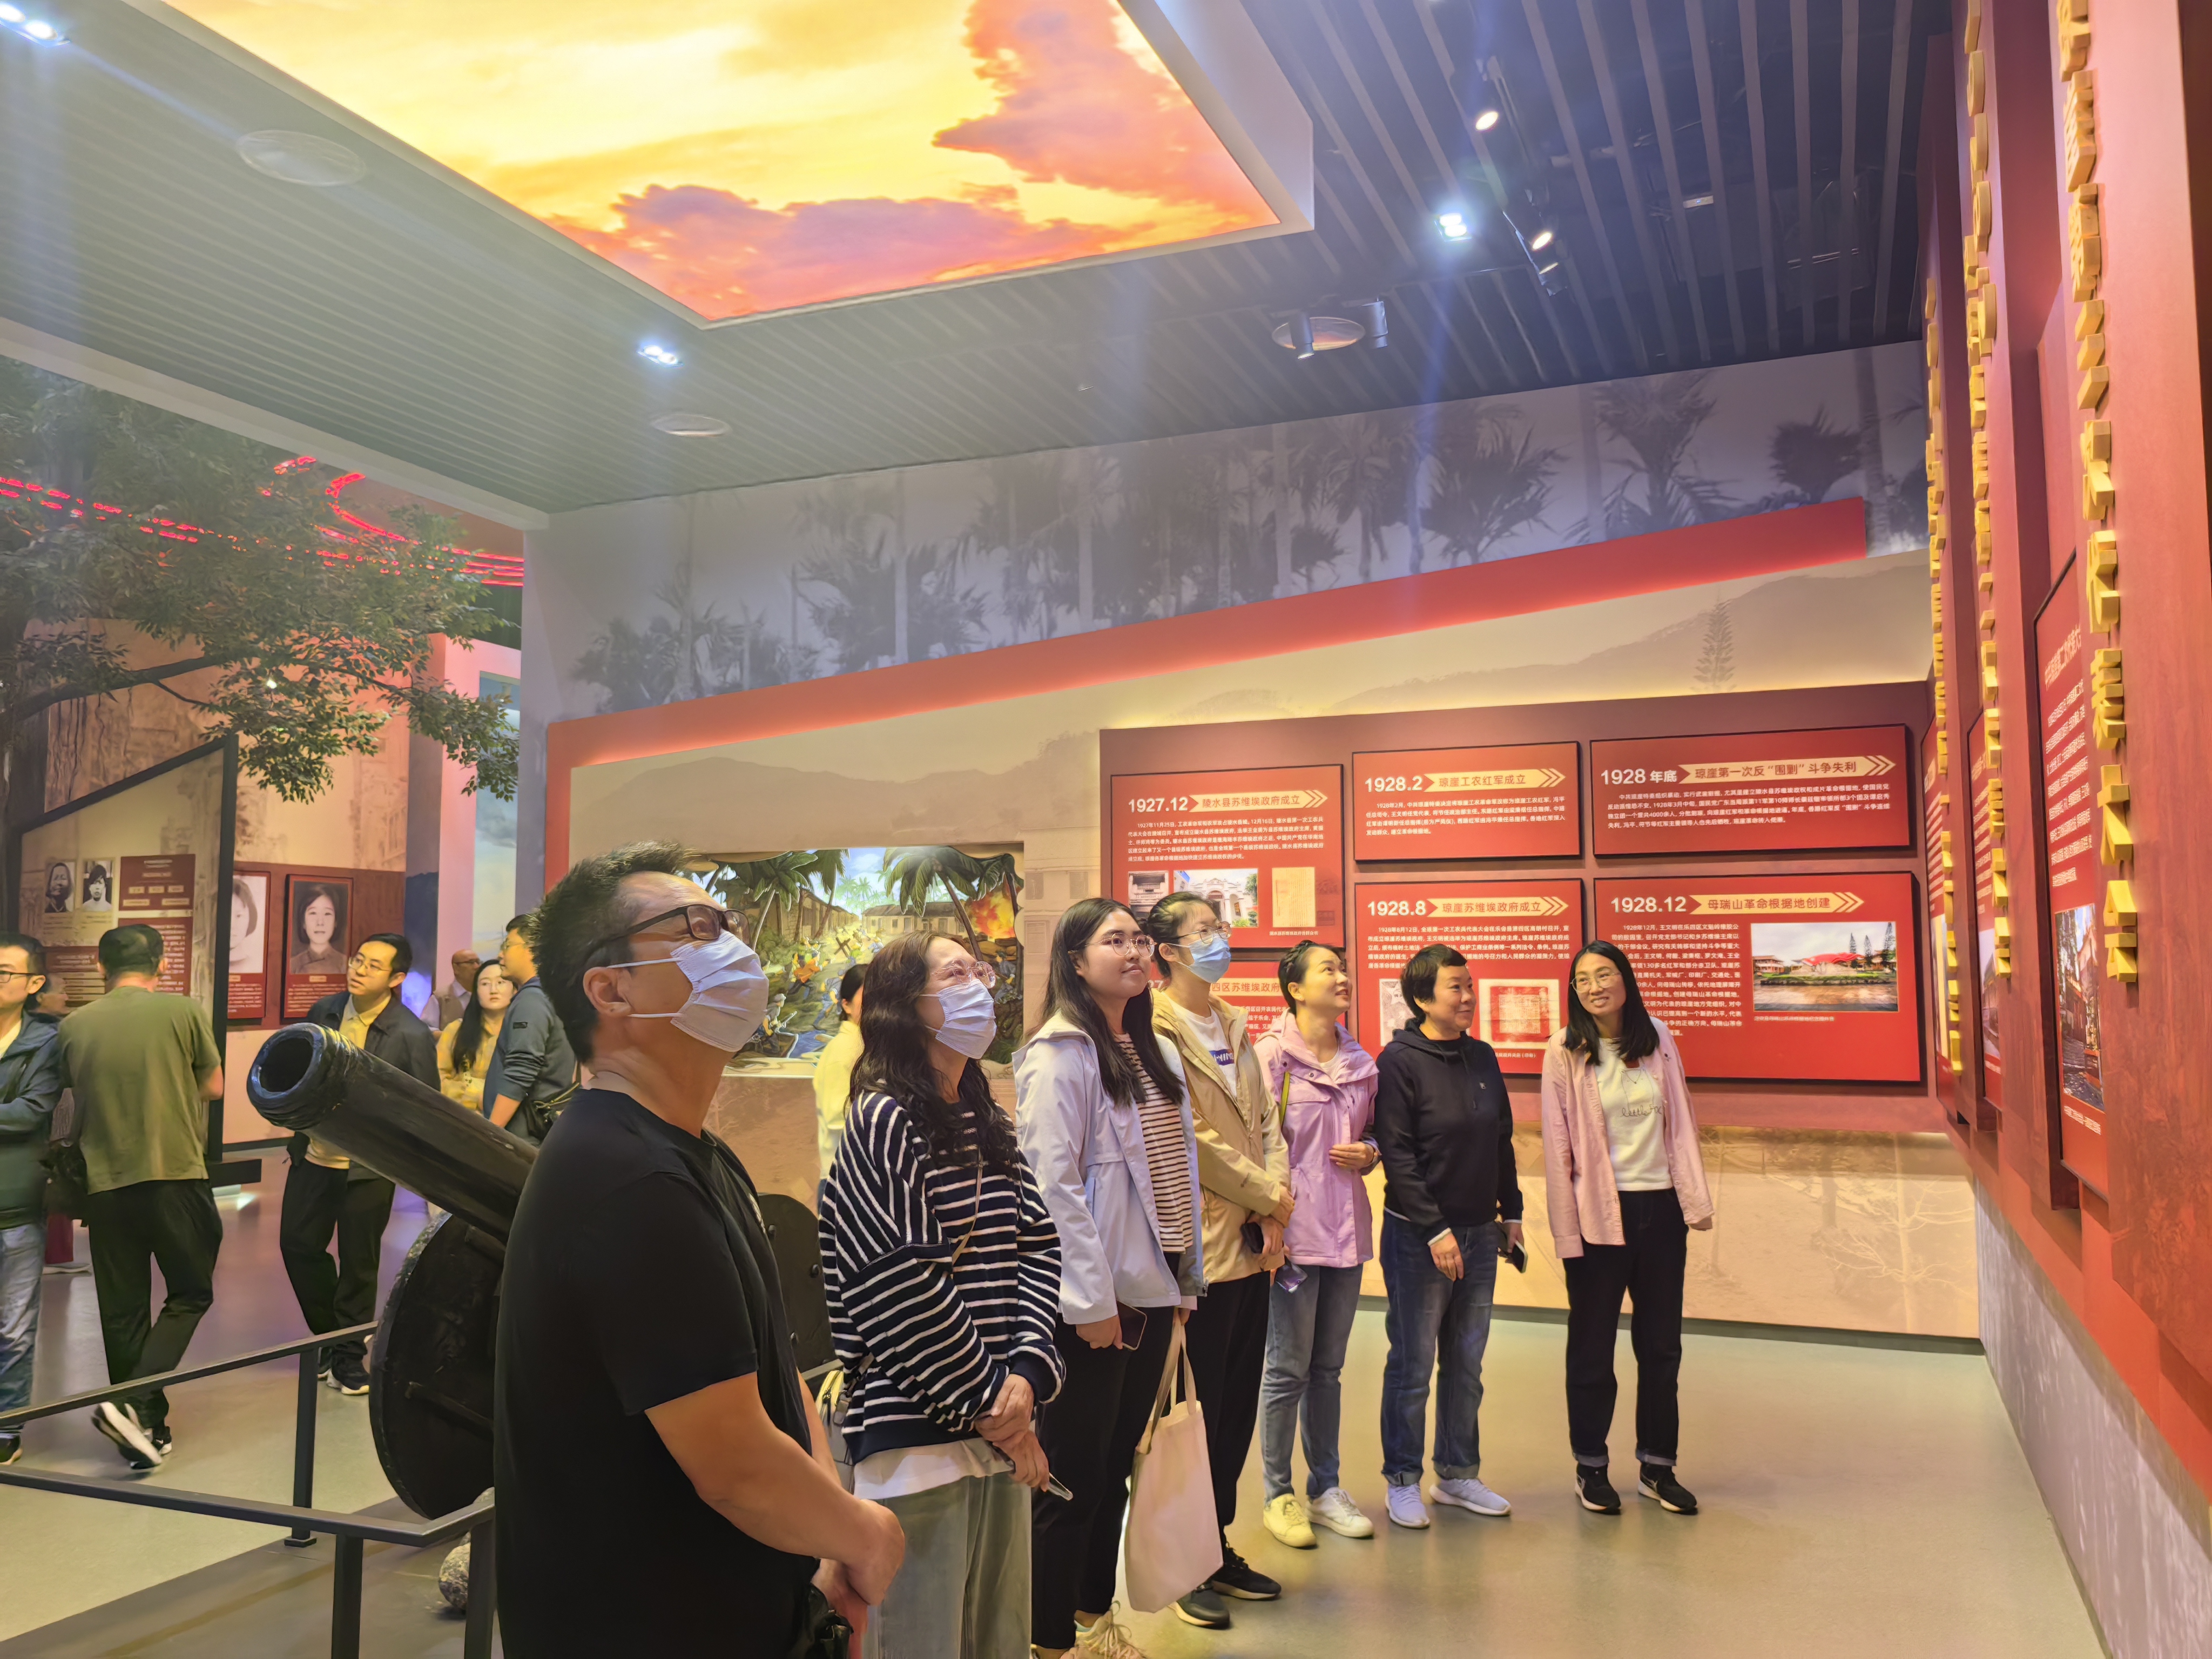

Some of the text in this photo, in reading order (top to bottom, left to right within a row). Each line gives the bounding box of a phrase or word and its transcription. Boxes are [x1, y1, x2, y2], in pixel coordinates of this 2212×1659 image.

[1365, 774, 1526, 793] 1928.2 琼崖工农红军成立
[1601, 768, 1646, 785] 1928
[1650, 770, 1677, 783] 年底
[1128, 794, 1300, 813] 1927.12 陵水县苏维埃政府成立
[1367, 901, 1541, 916] 1928.8 琼崖苏维埃政府成立
[1611, 896, 1830, 913] 1928.12 母瑞山革命根据地创建
